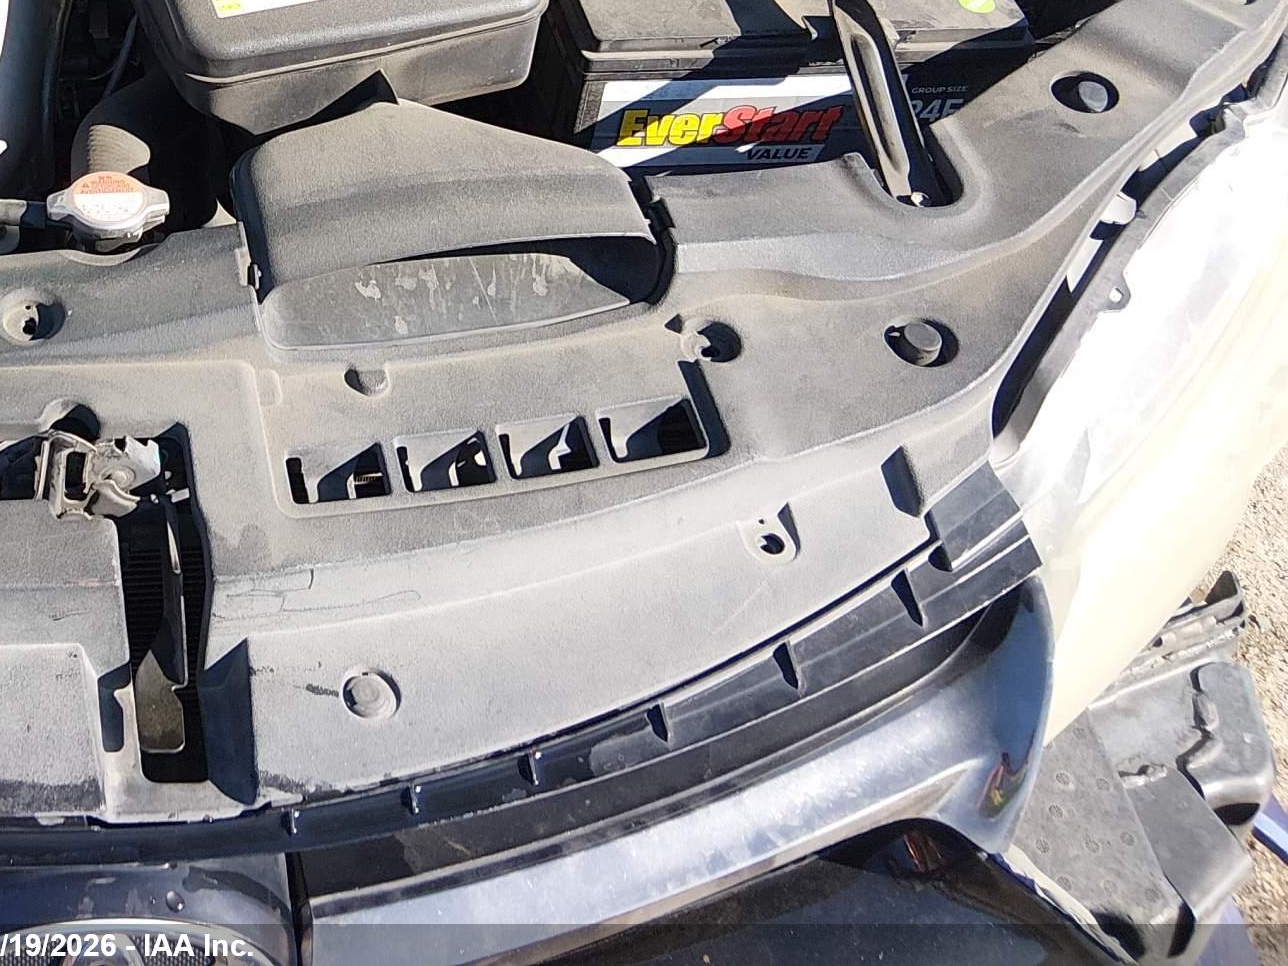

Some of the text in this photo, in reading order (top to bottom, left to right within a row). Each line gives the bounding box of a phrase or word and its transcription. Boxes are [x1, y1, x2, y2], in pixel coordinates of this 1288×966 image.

[912, 85, 969, 94] GROUP SIZE
[617, 105, 843, 146] EverStart
[745, 146, 812, 161] VALUE
